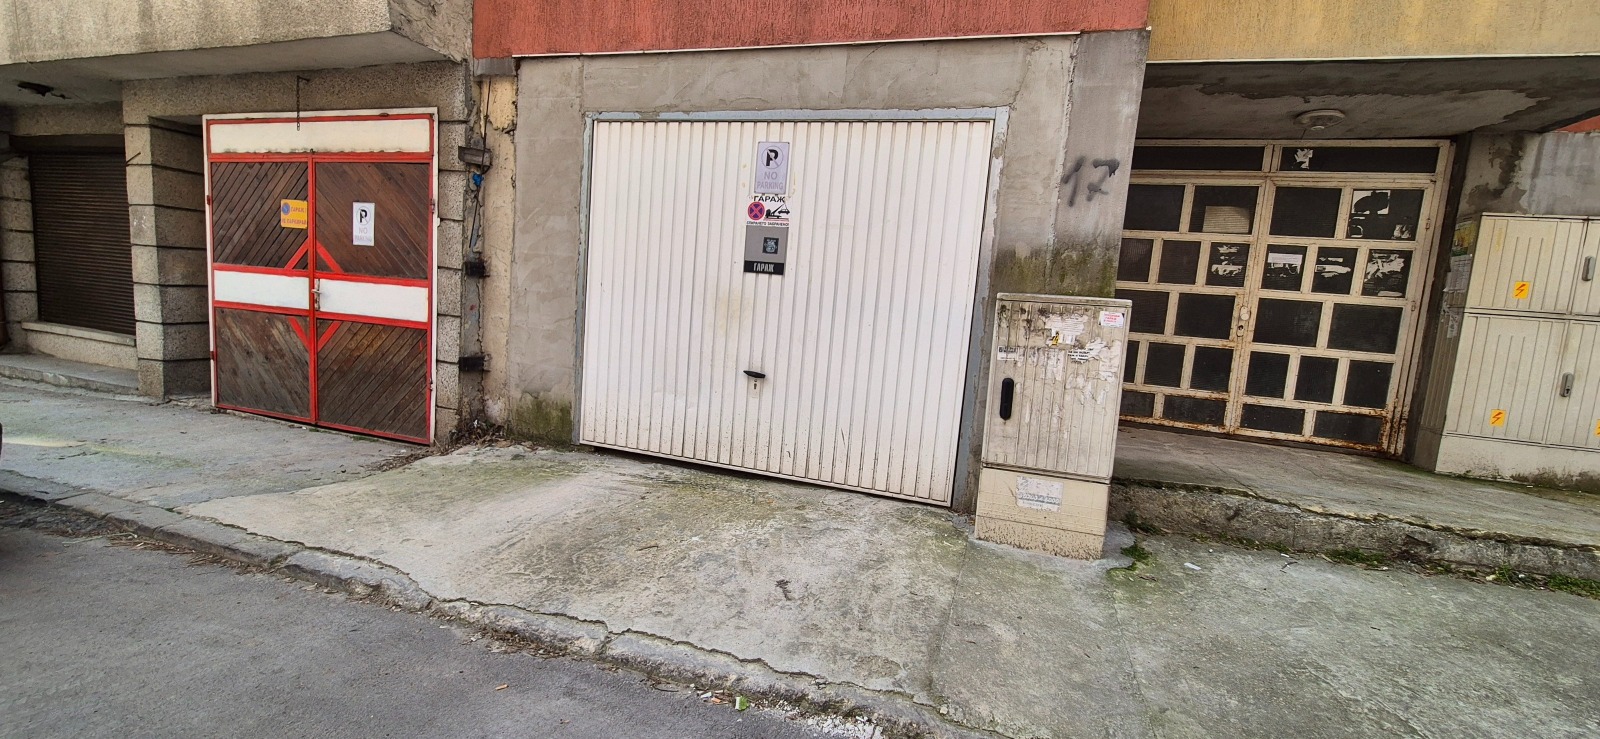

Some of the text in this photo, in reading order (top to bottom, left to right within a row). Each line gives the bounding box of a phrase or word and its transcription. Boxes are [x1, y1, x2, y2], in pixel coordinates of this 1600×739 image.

[764, 171, 778, 180] NO
[757, 181, 784, 190] PARKING
[1061, 155, 1120, 207] 17
[753, 195, 786, 203] ГАРАЖ
[359, 227, 368, 235] NO
[753, 262, 775, 273] ГАРАЖ
